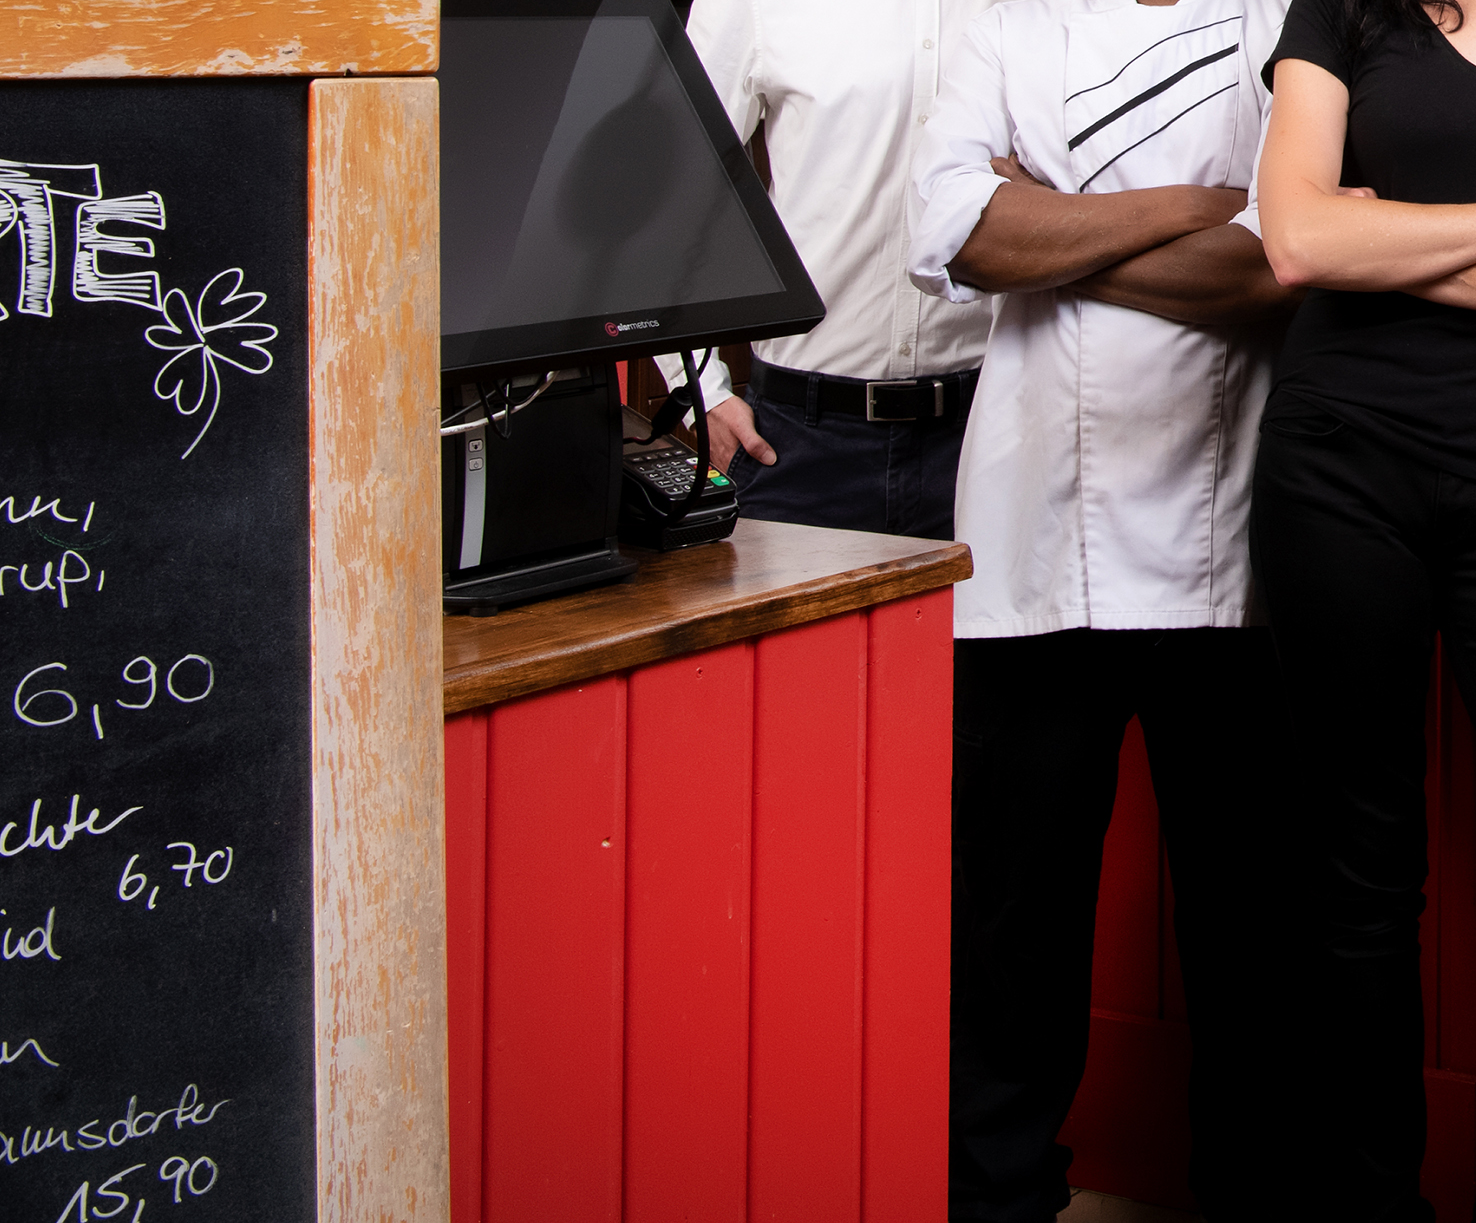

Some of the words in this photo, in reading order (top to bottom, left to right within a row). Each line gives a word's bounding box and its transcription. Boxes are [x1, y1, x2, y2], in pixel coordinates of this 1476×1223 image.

[14, 654, 214, 739] 6,90
[118, 842, 234, 909] 6,70
[56, 1155, 218, 1223] 15,90
